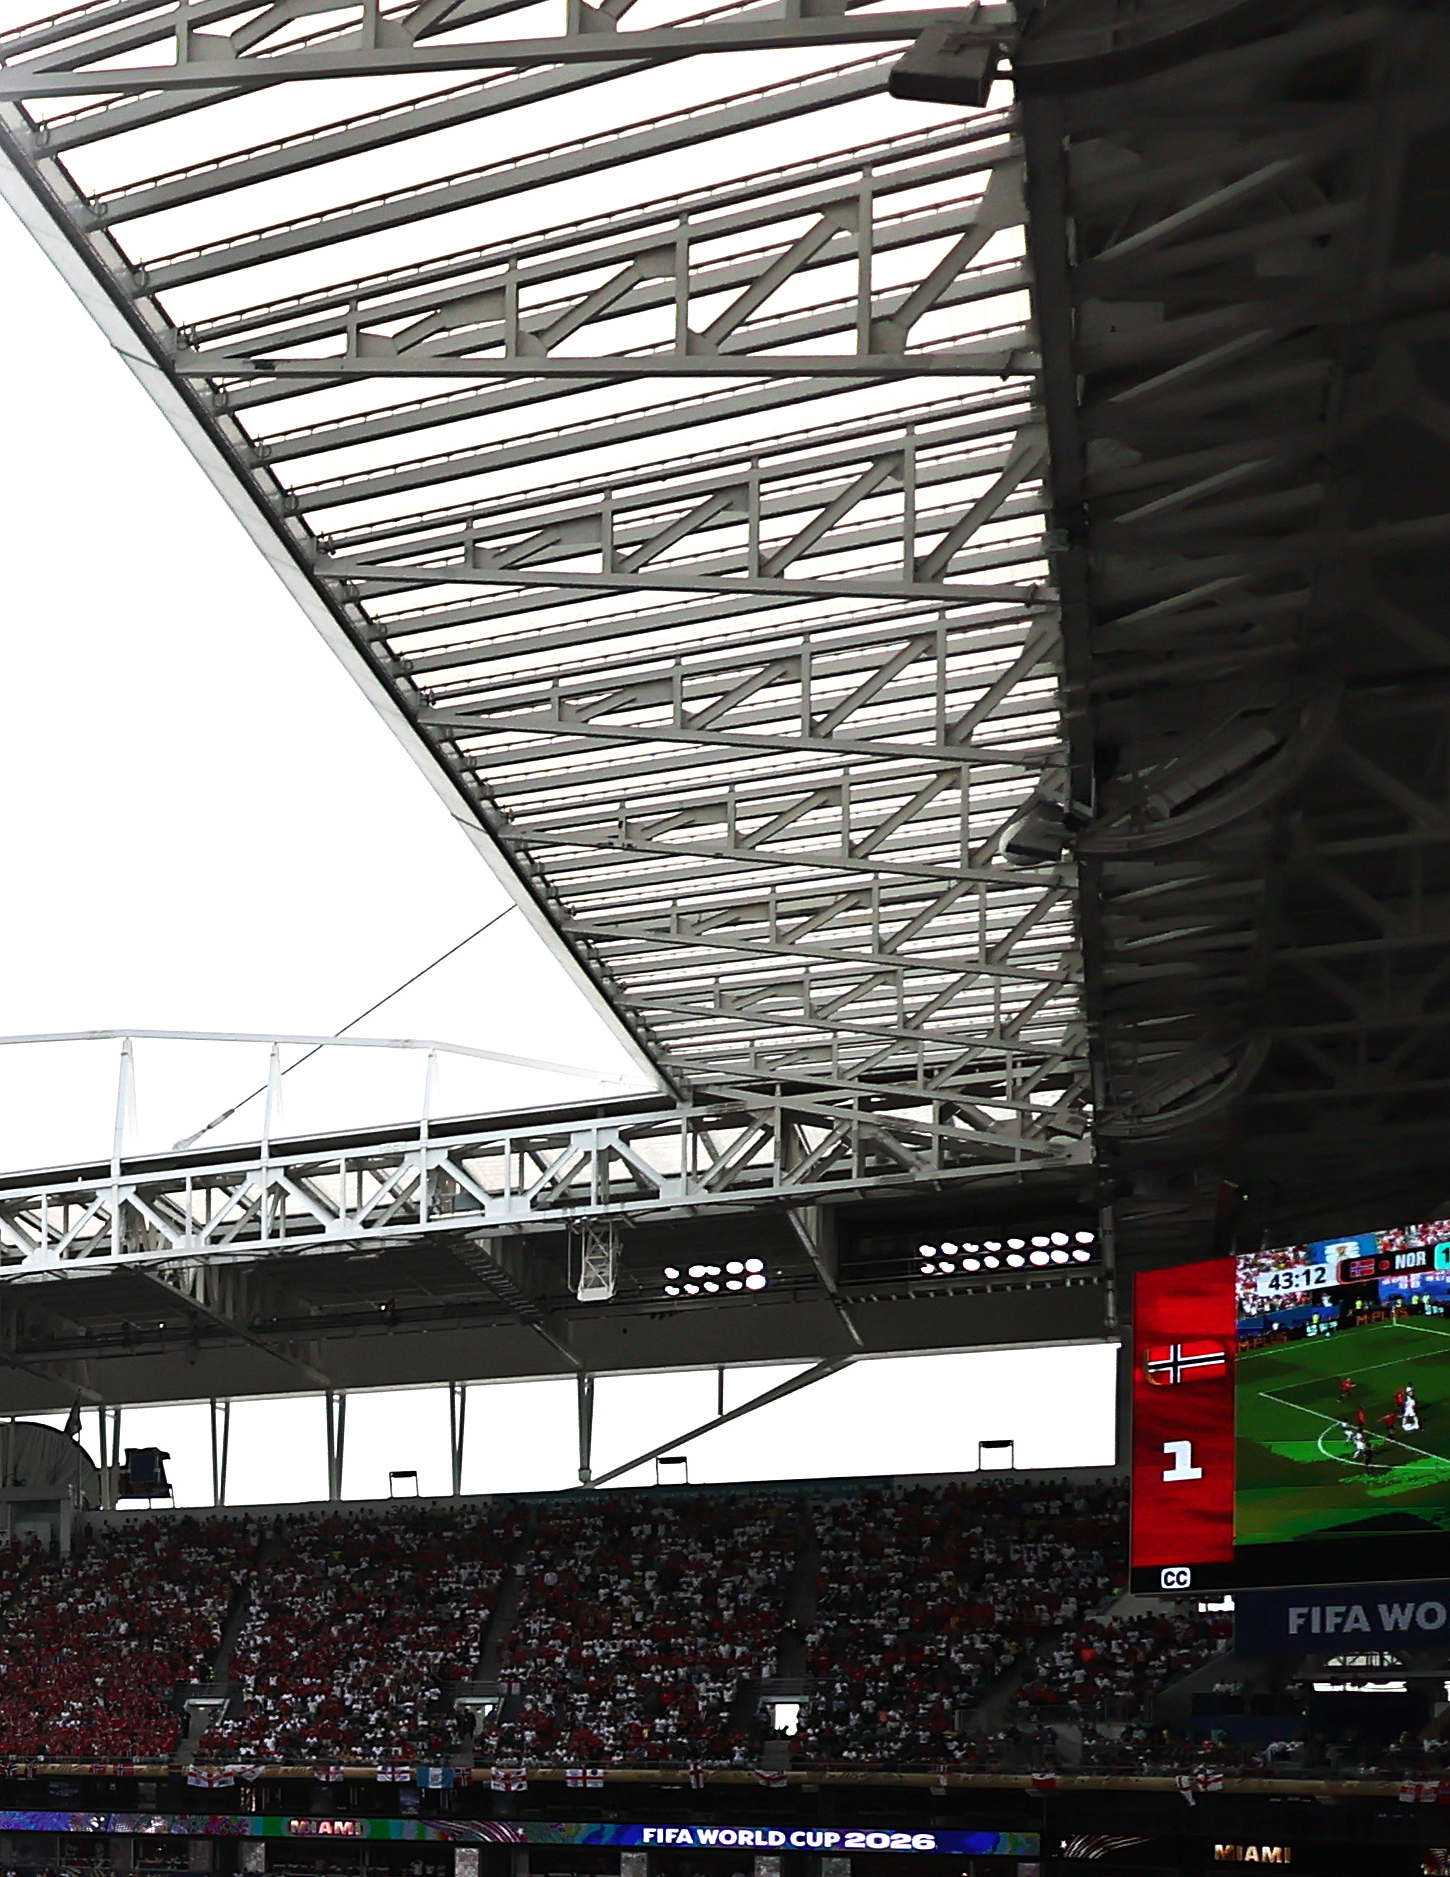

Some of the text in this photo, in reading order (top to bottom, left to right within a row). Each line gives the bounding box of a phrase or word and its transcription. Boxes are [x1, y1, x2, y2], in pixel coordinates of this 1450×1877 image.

[1395, 1251, 1426, 1269] NOR
[1267, 1265, 1328, 1291] 43:12
[1163, 1441, 1202, 1481] 1
[1164, 1570, 1188, 1587] CC
[1289, 1605, 1371, 1634] FIFA
[290, 1820, 362, 1836] MIAMI
[643, 1828, 935, 1849] FIFA WORLD CUP 2026
[1214, 1844, 1291, 1864] MIAMI
